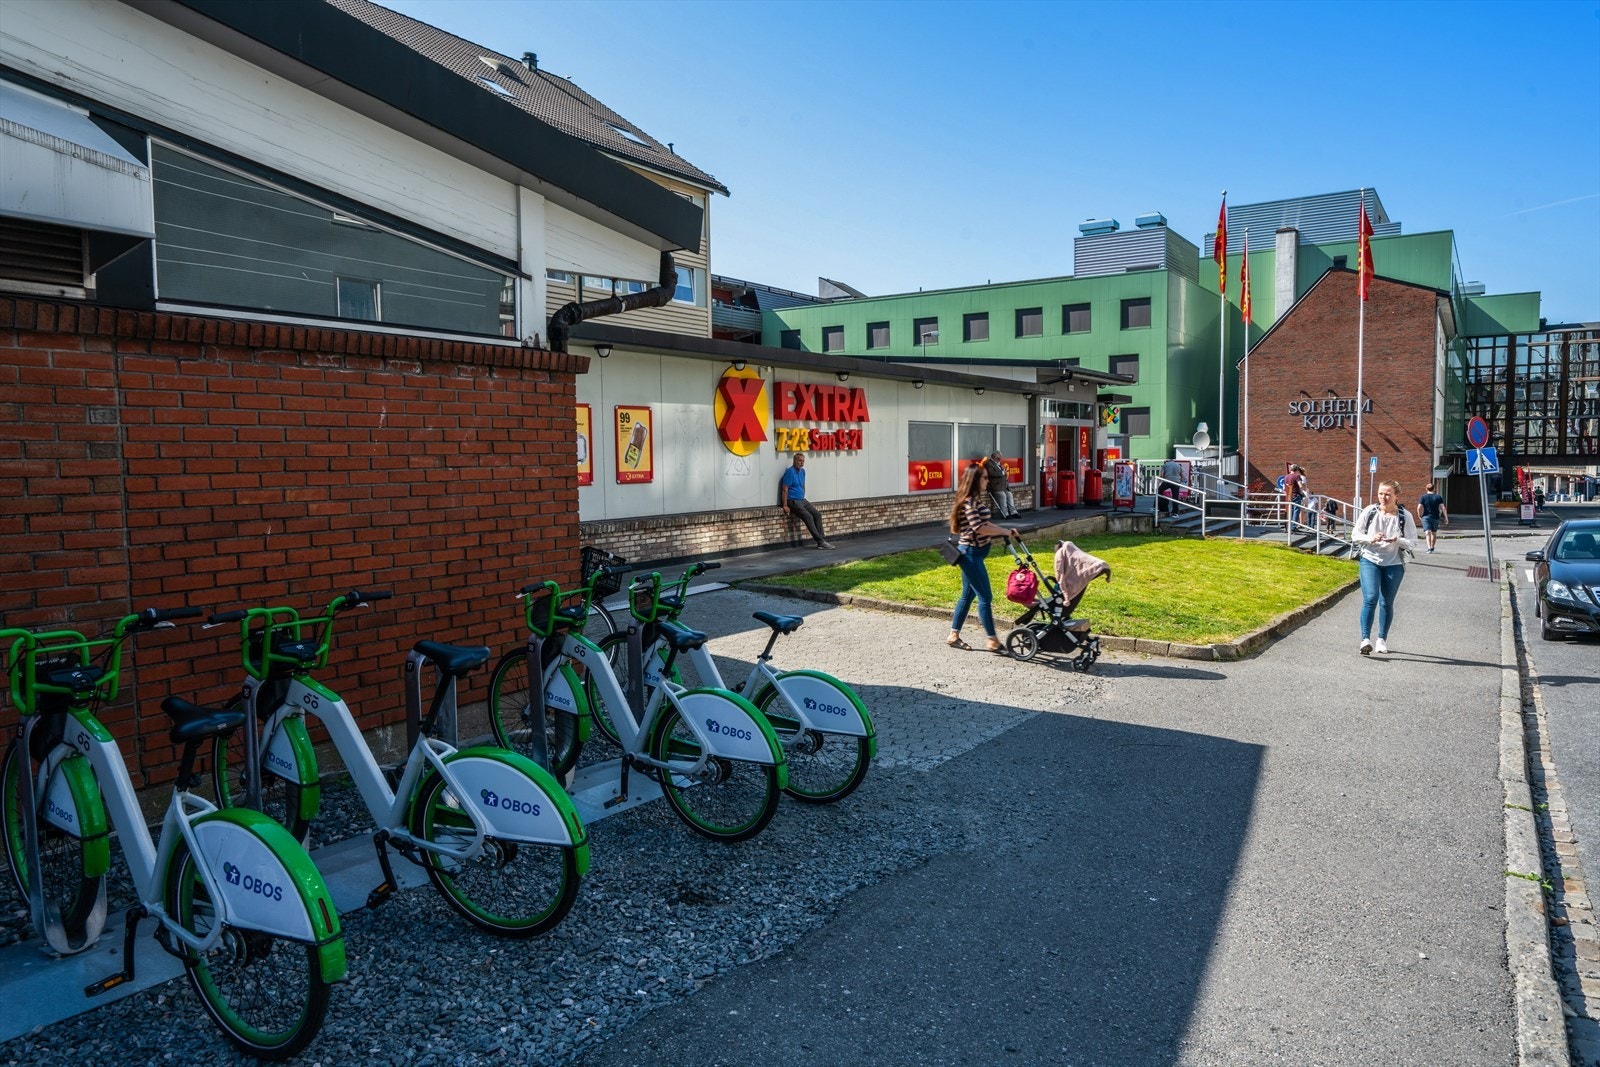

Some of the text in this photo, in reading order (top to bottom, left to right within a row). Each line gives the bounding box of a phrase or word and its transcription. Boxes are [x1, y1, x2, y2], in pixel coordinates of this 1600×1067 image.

[774, 381, 870, 422] EXTRA
[1288, 398, 1373, 416] SOLHEIM
[619, 411, 631, 424] 99
[1303, 412, 1360, 431] KJØTT
[776, 427, 863, 452] 7-23 Søn 9-21
[928, 471, 943, 480] EXTRA
[1009, 467, 1021, 475] EXTRA
[554, 695, 570, 706] OBOS
[818, 703, 847, 717] OBOS
[721, 725, 752, 741] OBOS
[275, 757, 293, 771] OBOS
[55, 806, 73, 823] OBOS
[501, 797, 541, 817] OBOS
[243, 874, 283, 902] OBOS
